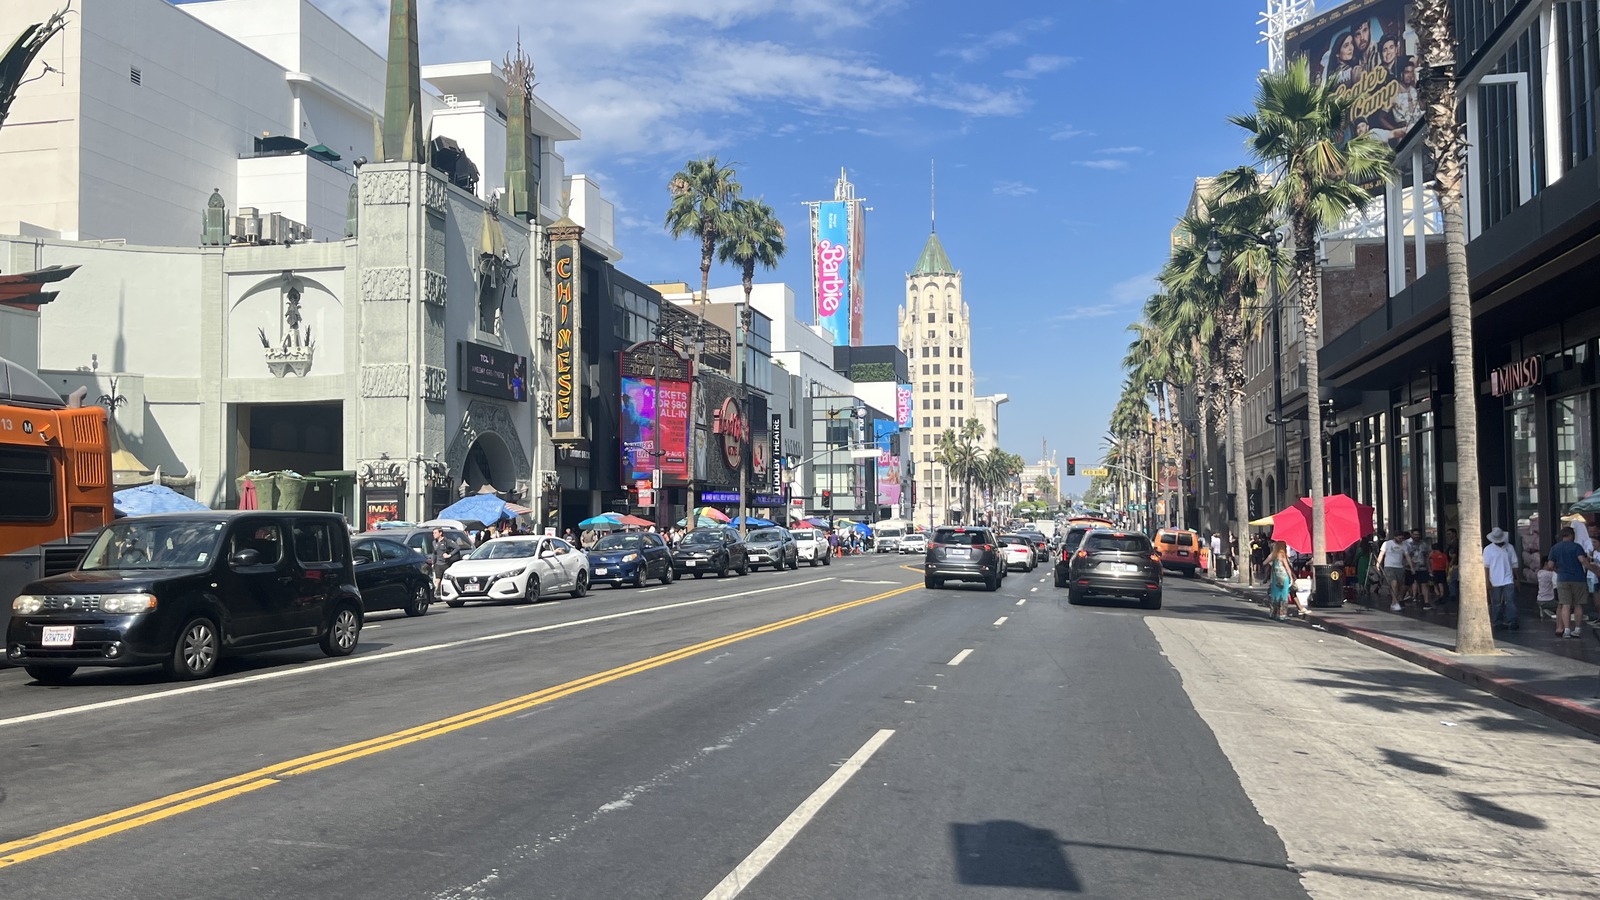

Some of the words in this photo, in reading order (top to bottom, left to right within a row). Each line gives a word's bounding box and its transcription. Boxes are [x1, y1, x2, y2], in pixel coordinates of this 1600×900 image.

[1350, 80, 1399, 120] Camp
[820, 240, 845, 312] Barbie
[556, 257, 572, 419] CHINESE
[1500, 356, 1538, 393] MINISO
[644, 388, 650, 397] 4
[651, 389, 687, 401] TCKETS
[671, 399, 687, 410] $80
[898, 387, 910, 426] Barbie
[660, 408, 687, 419] ALL-IN
[772, 418, 780, 455] THEATRE
[772, 458, 780, 486] DOLBY
